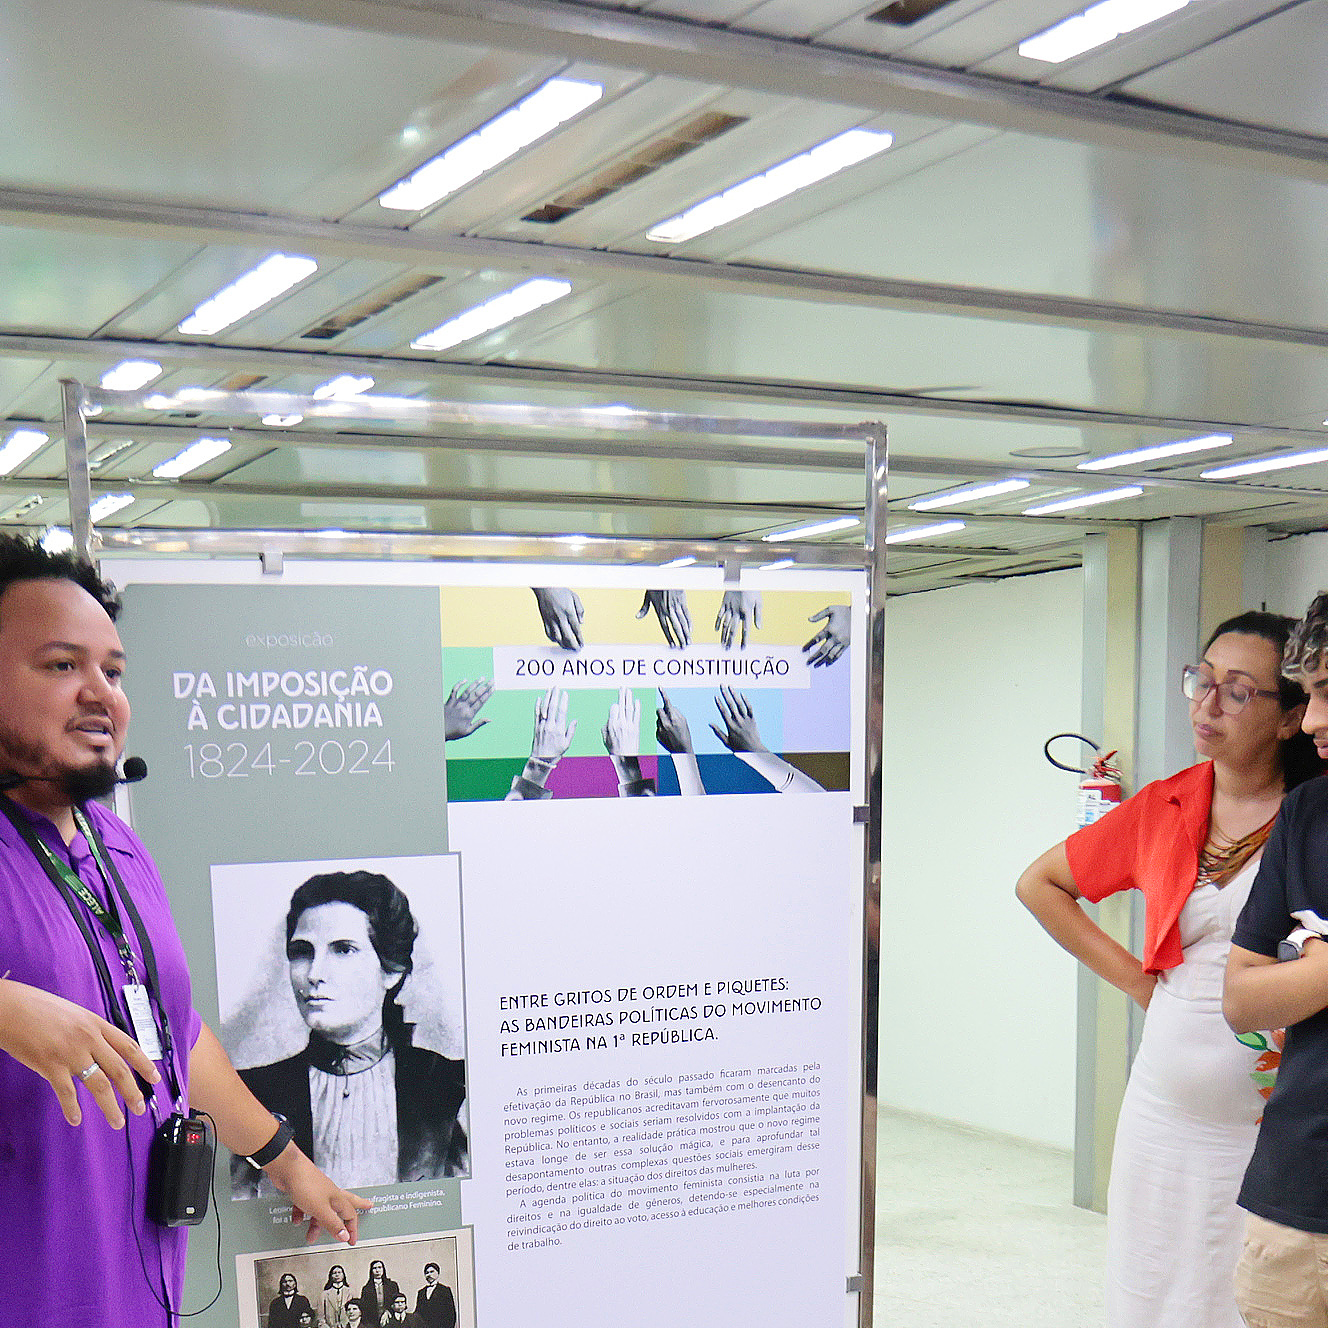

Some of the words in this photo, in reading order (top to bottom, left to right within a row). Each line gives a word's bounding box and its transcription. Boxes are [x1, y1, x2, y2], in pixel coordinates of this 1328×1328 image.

[173, 671, 217, 699] DA
[226, 665, 394, 703] IMPOSIÇÃO
[515, 659, 555, 676] 200
[562, 659, 616, 676] ANOS
[623, 659, 647, 676] DE
[653, 656, 790, 680] CONSTITUIÇÃO
[187, 699, 209, 731] À
[216, 701, 384, 730] CIDADANIA
[183, 737, 396, 779] 1824-2024
[500, 994, 549, 1011] ENTRE
[554, 990, 612, 1007] GRITOS
[618, 988, 638, 1002] DE
[642, 984, 698, 1000] ORDEM
[704, 983, 712, 996] E
[717, 978, 789, 996] PIQUETES:
[500, 1019, 520, 1034] AS
[525, 1013, 614, 1032] BANDEIRAS
[619, 1006, 698, 1025] POLÍTICAS
[703, 1004, 726, 1019] DO
[732, 997, 822, 1017] MOVIMENTO
[501, 1038, 581, 1057] FEMINISTA
[586, 1035, 607, 1051] NA
[613, 1033, 625, 1048] 1ª
[631, 1028, 719, 1047] REPÚBLICA.
[503, 1099, 552, 1113] efetivação
[554, 1097, 567, 1108] da
[570, 1093, 615, 1107] República
[619, 1093, 632, 1101] no
[634, 1088, 661, 1100] Brasil,
[663, 1088, 682, 1097] mas
[685, 1084, 723, 1096] também
[725, 1083, 745, 1092] com
[747, 1082, 754, 1090] o
[756, 1077, 807, 1089] desencanto
[809, 1074, 821, 1084] do
[516, 1087, 528, 1097] As
[534, 1083, 578, 1097] primeiras
[582, 1079, 621, 1091] décadas
[626, 1077, 639, 1087] do
[644, 1073, 673, 1086] século
[678, 1070, 715, 1084] passado
[720, 1068, 752, 1078] ficaram
[757, 1063, 798, 1075] marcadas
[802, 1061, 821, 1074] pela
[503, 1117, 528, 1126] novo
[531, 1113, 566, 1126] regime.
[568, 1110, 581, 1120] Os
[584, 1106, 643, 1120] republicanos
[645, 1101, 700, 1113] acreditavam
[702, 1094, 770, 1107] fervorosamente
[772, 1092, 789, 1102] que
[791, 1089, 821, 1099] muitos
[504, 1128, 554, 1143] problemas
[557, 1124, 597, 1137] políticos
[600, 1123, 606, 1131] e
[609, 1119, 639, 1130] sociais
[642, 1116, 672, 1127] seriam
[676, 1111, 720, 1124] resolvidos
[723, 1110, 742, 1119] com
[745, 1109, 751, 1117] a
[754, 1103, 807, 1117] implantação
[809, 1101, 821, 1111] da
[504, 1142, 553, 1156] República.
[556, 1139, 570, 1149] No
[572, 1136, 611, 1148] entanto,
[613, 1136, 619, 1144] a
[622, 1129, 664, 1142] realidade
[666, 1127, 697, 1140] prática
[699, 1124, 736, 1135] mostrou
[738, 1122, 756, 1133] que
[757, 1121, 765, 1129] o
[766, 1119, 789, 1128] novo
[791, 1115, 821, 1127] regime
[504, 1158, 535, 1169] estava
[541, 1155, 569, 1166] longe
[574, 1151, 587, 1161] de
[593, 1151, 607, 1159] ser
[613, 1148, 633, 1157] essa
[639, 1142, 674, 1155] solução
[679, 1139, 714, 1151] mágica,
[731, 1136, 751, 1147] para
[756, 1129, 804, 1144] aprofundar
[809, 1127, 820, 1137] tal
[505, 1166, 585, 1183] desapontamento
[588, 1163, 617, 1174] outras
[620, 1158, 669, 1170] complexas
[671, 1152, 712, 1166] questões
[715, 1149, 744, 1160] sociais
[747, 1145, 793, 1157] emergiram
[796, 1142, 821, 1152] desse
[505, 1183, 545, 1199] período,
[546, 1181, 577, 1192] dentre
[578, 1178, 599, 1189] elas:
[600, 1178, 606, 1186] a
[607, 1173, 645, 1185] situação
[646, 1171, 663, 1181] dos
[664, 1168, 698, 1179] direitos
[699, 1165, 715, 1175] das
[716, 1162, 758, 1173] mulheres.
[506, 1213, 542, 1224] direitos
[559, 1209, 571, 1218] na
[577, 1202, 622, 1218] igualdade
[627, 1200, 640, 1210] de
[645, 1197, 683, 1210] gêneros,
[688, 1190, 738, 1203] detendo-se
[743, 1183, 804, 1197] especialmente
[809, 1181, 820, 1189] na
[519, 1199, 527, 1209] A
[531, 1195, 567, 1209] agenda
[571, 1191, 605, 1205] política
[610, 1188, 623, 1199] do
[627, 1184, 679, 1196] movimento
[683, 1178, 723, 1190] feminista
[727, 1174, 765, 1185] consistia
[769, 1173, 780, 1181] na
[784, 1170, 801, 1179] luta
[805, 1168, 820, 1179] por
[368, 1203, 408, 1214] epublicano
[507, 1222, 568, 1238] reivindicação
[569, 1220, 582, 1230] do
[583, 1217, 613, 1229] direito
[614, 1217, 626, 1225] ao
[626, 1214, 649, 1223] voto,
[650, 1210, 680, 1221] acesso
[680, 1208, 687, 1217] à
[687, 1203, 730, 1217] educação
[730, 1204, 736, 1212] e
[737, 1199, 777, 1211] melhores
[777, 1193, 820, 1206] condições
[507, 1241, 520, 1251] de
[521, 1237, 563, 1250] trabalho.
